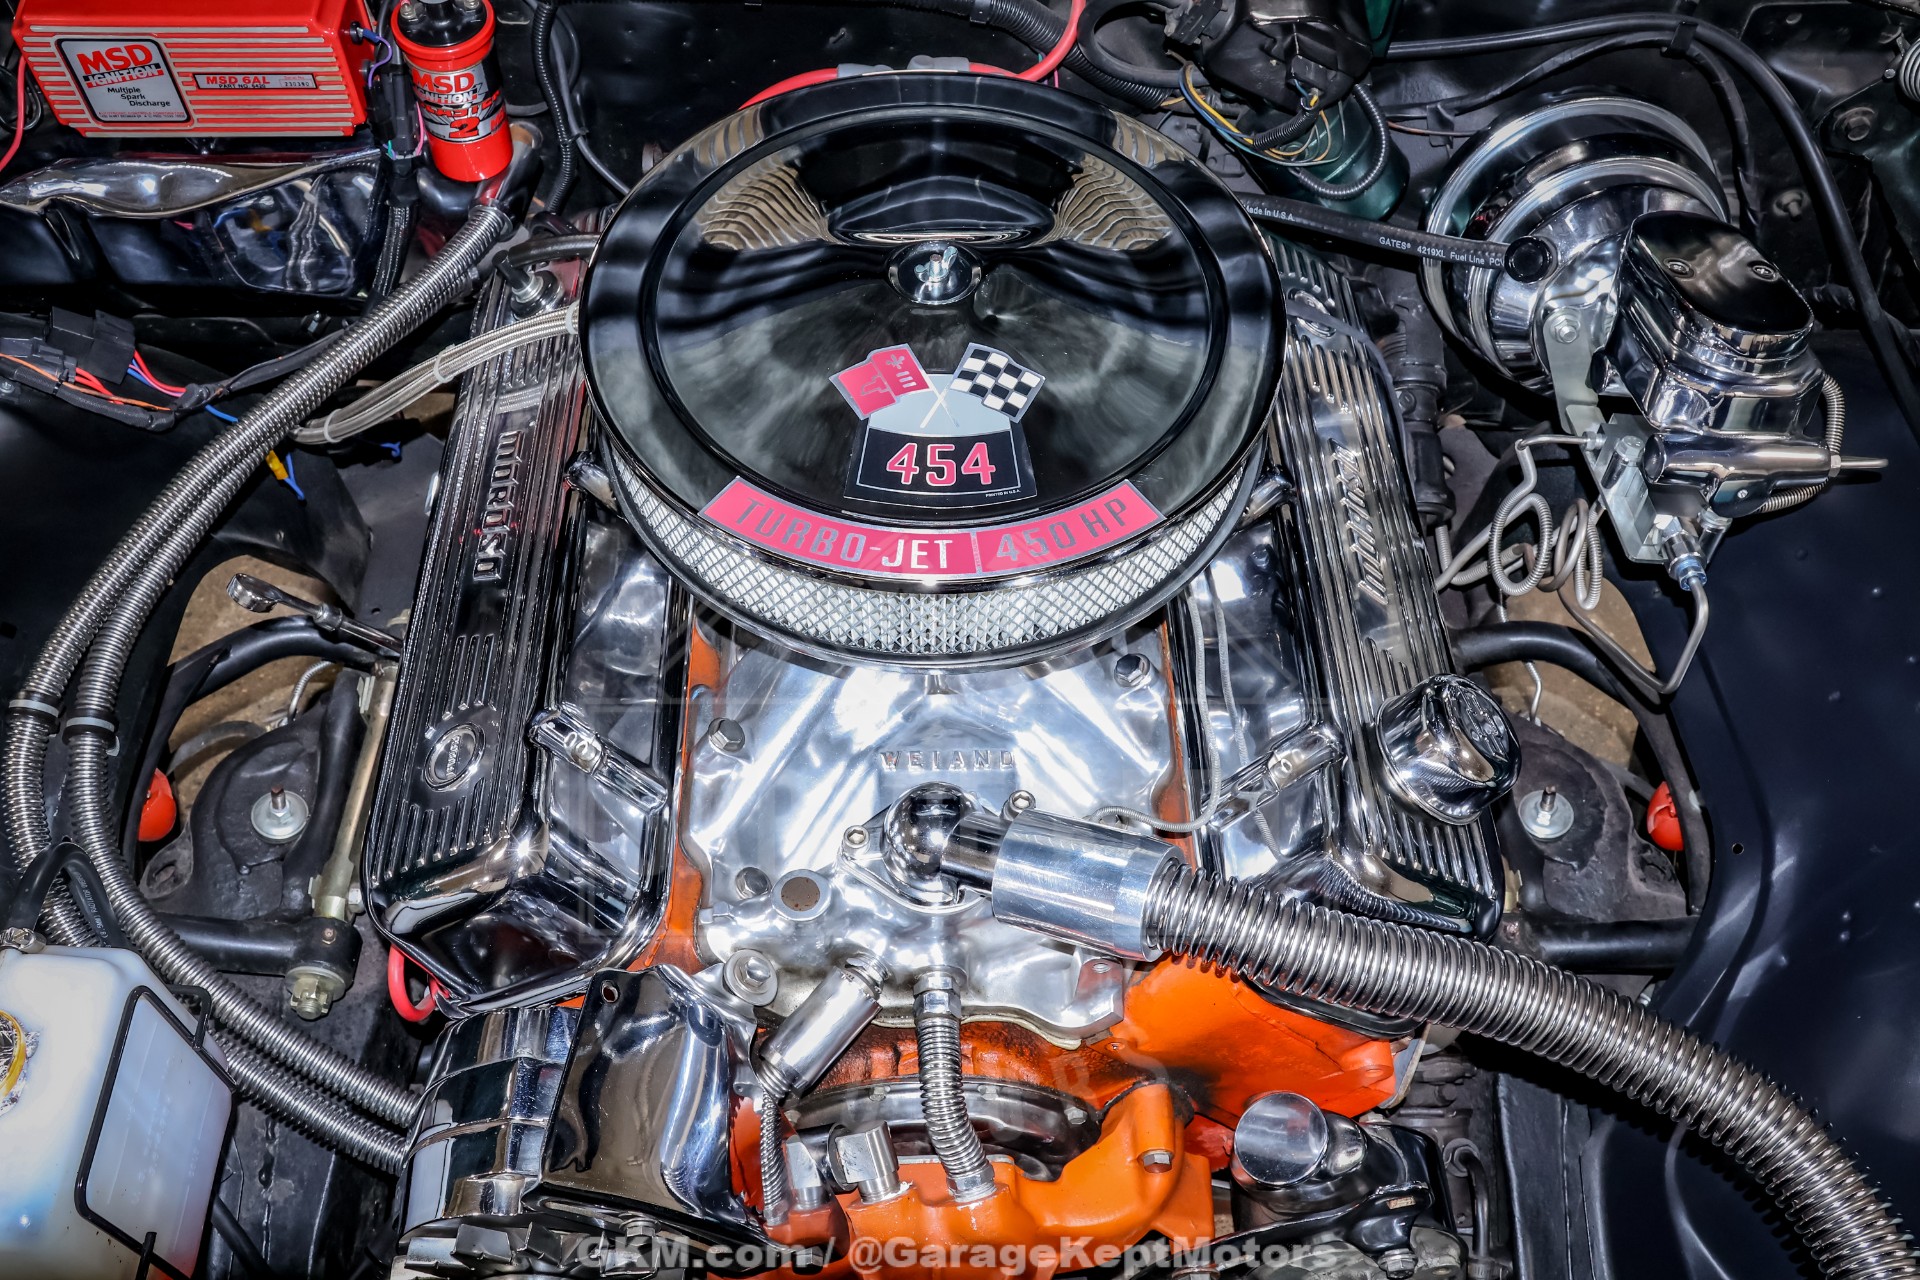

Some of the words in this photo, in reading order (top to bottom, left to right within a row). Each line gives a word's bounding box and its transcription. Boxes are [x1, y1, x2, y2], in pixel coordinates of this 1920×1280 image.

[77, 44, 153, 75] MSD
[86, 63, 162, 87] IGNITION
[206, 76, 238, 84] MSD
[242, 76, 270, 84] 6AL
[411, 68, 475, 94] MSD
[107, 86, 141, 94] Multiple
[121, 94, 146, 102] Spark
[414, 86, 474, 105] GNITION
[129, 100, 171, 108] Discharge
[449, 117, 481, 138] 2
[1417, 245, 1446, 258] 4219XL
[1450, 251, 1467, 262] Fuel
[1469, 254, 1485, 265] Line
[886, 442, 996, 487] 454
[735, 497, 953, 570] TURBO-JET
[995, 521, 1077, 562] 450
[1079, 498, 1128, 539] HP
[881, 749, 1016, 773] WEIAND
